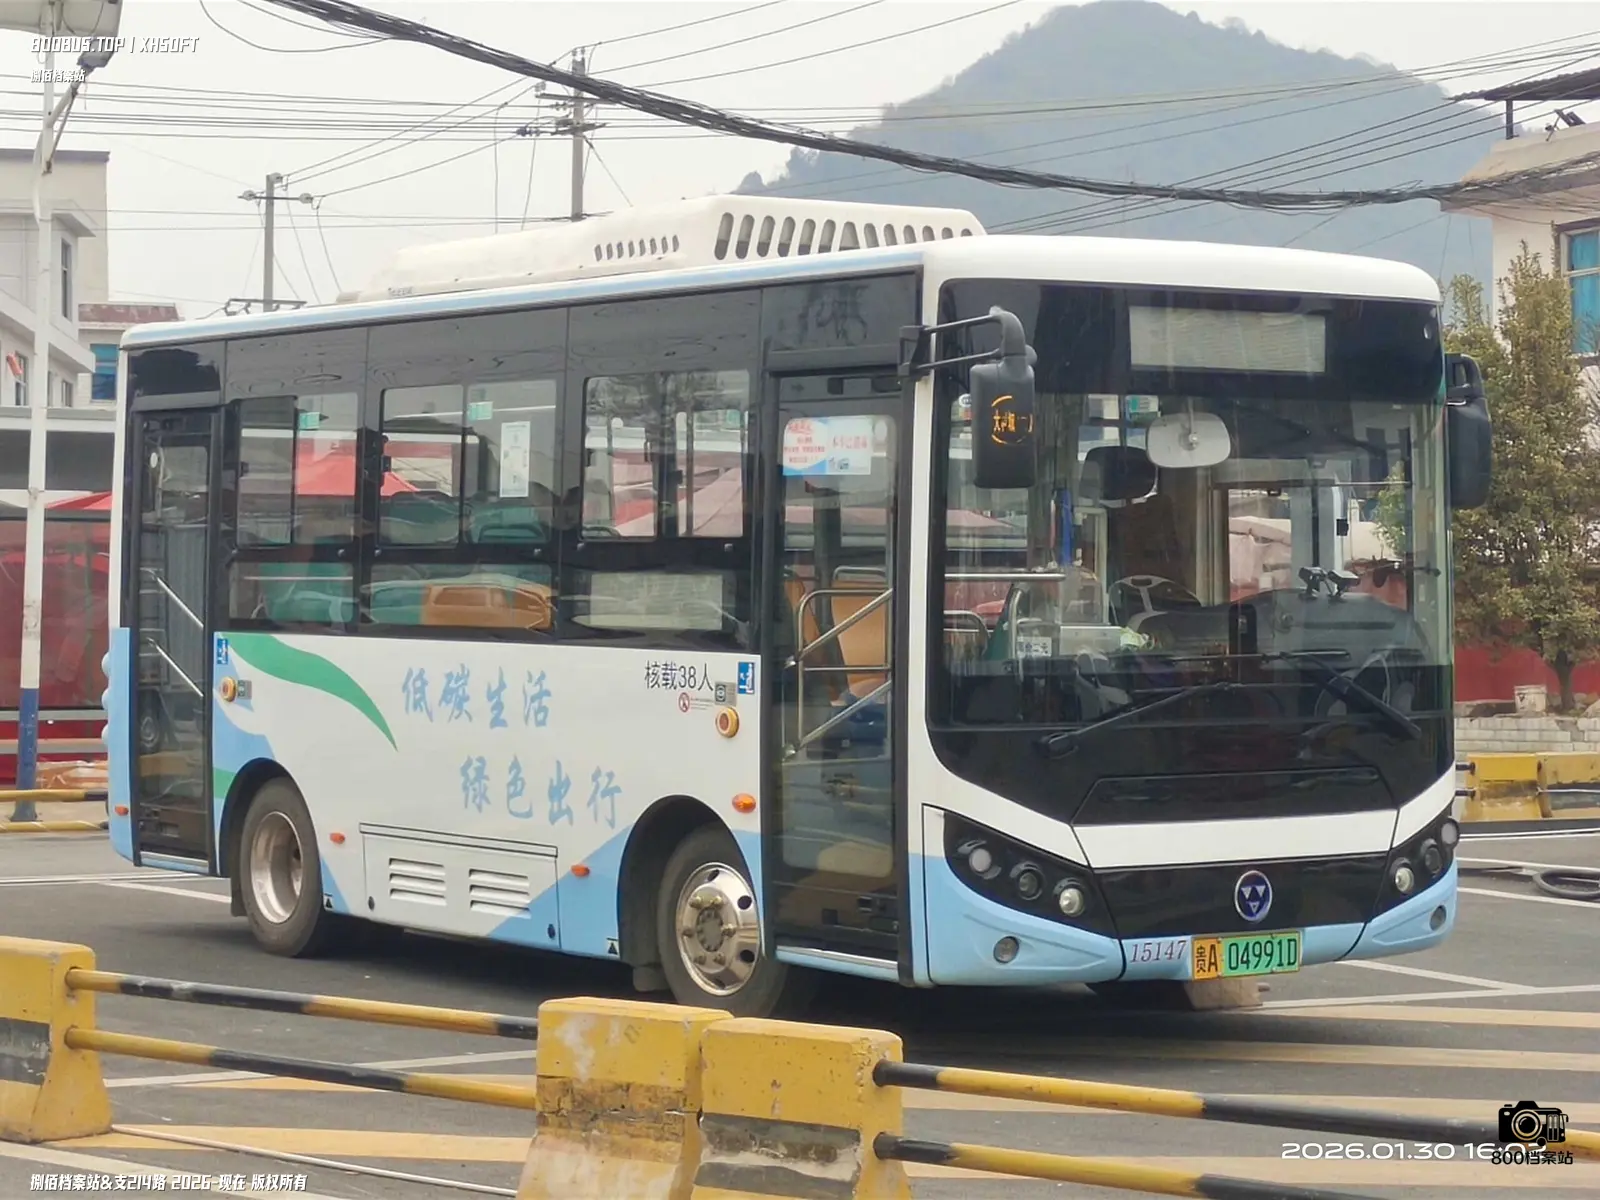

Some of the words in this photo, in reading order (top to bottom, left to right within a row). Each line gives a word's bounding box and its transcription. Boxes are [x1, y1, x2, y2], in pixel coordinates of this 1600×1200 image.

[402, 663, 551, 729] 低碳生活
[644, 660, 714, 692] 核载38人
[459, 753, 622, 830] 绿色出行
[1130, 940, 1187, 963] 15147
